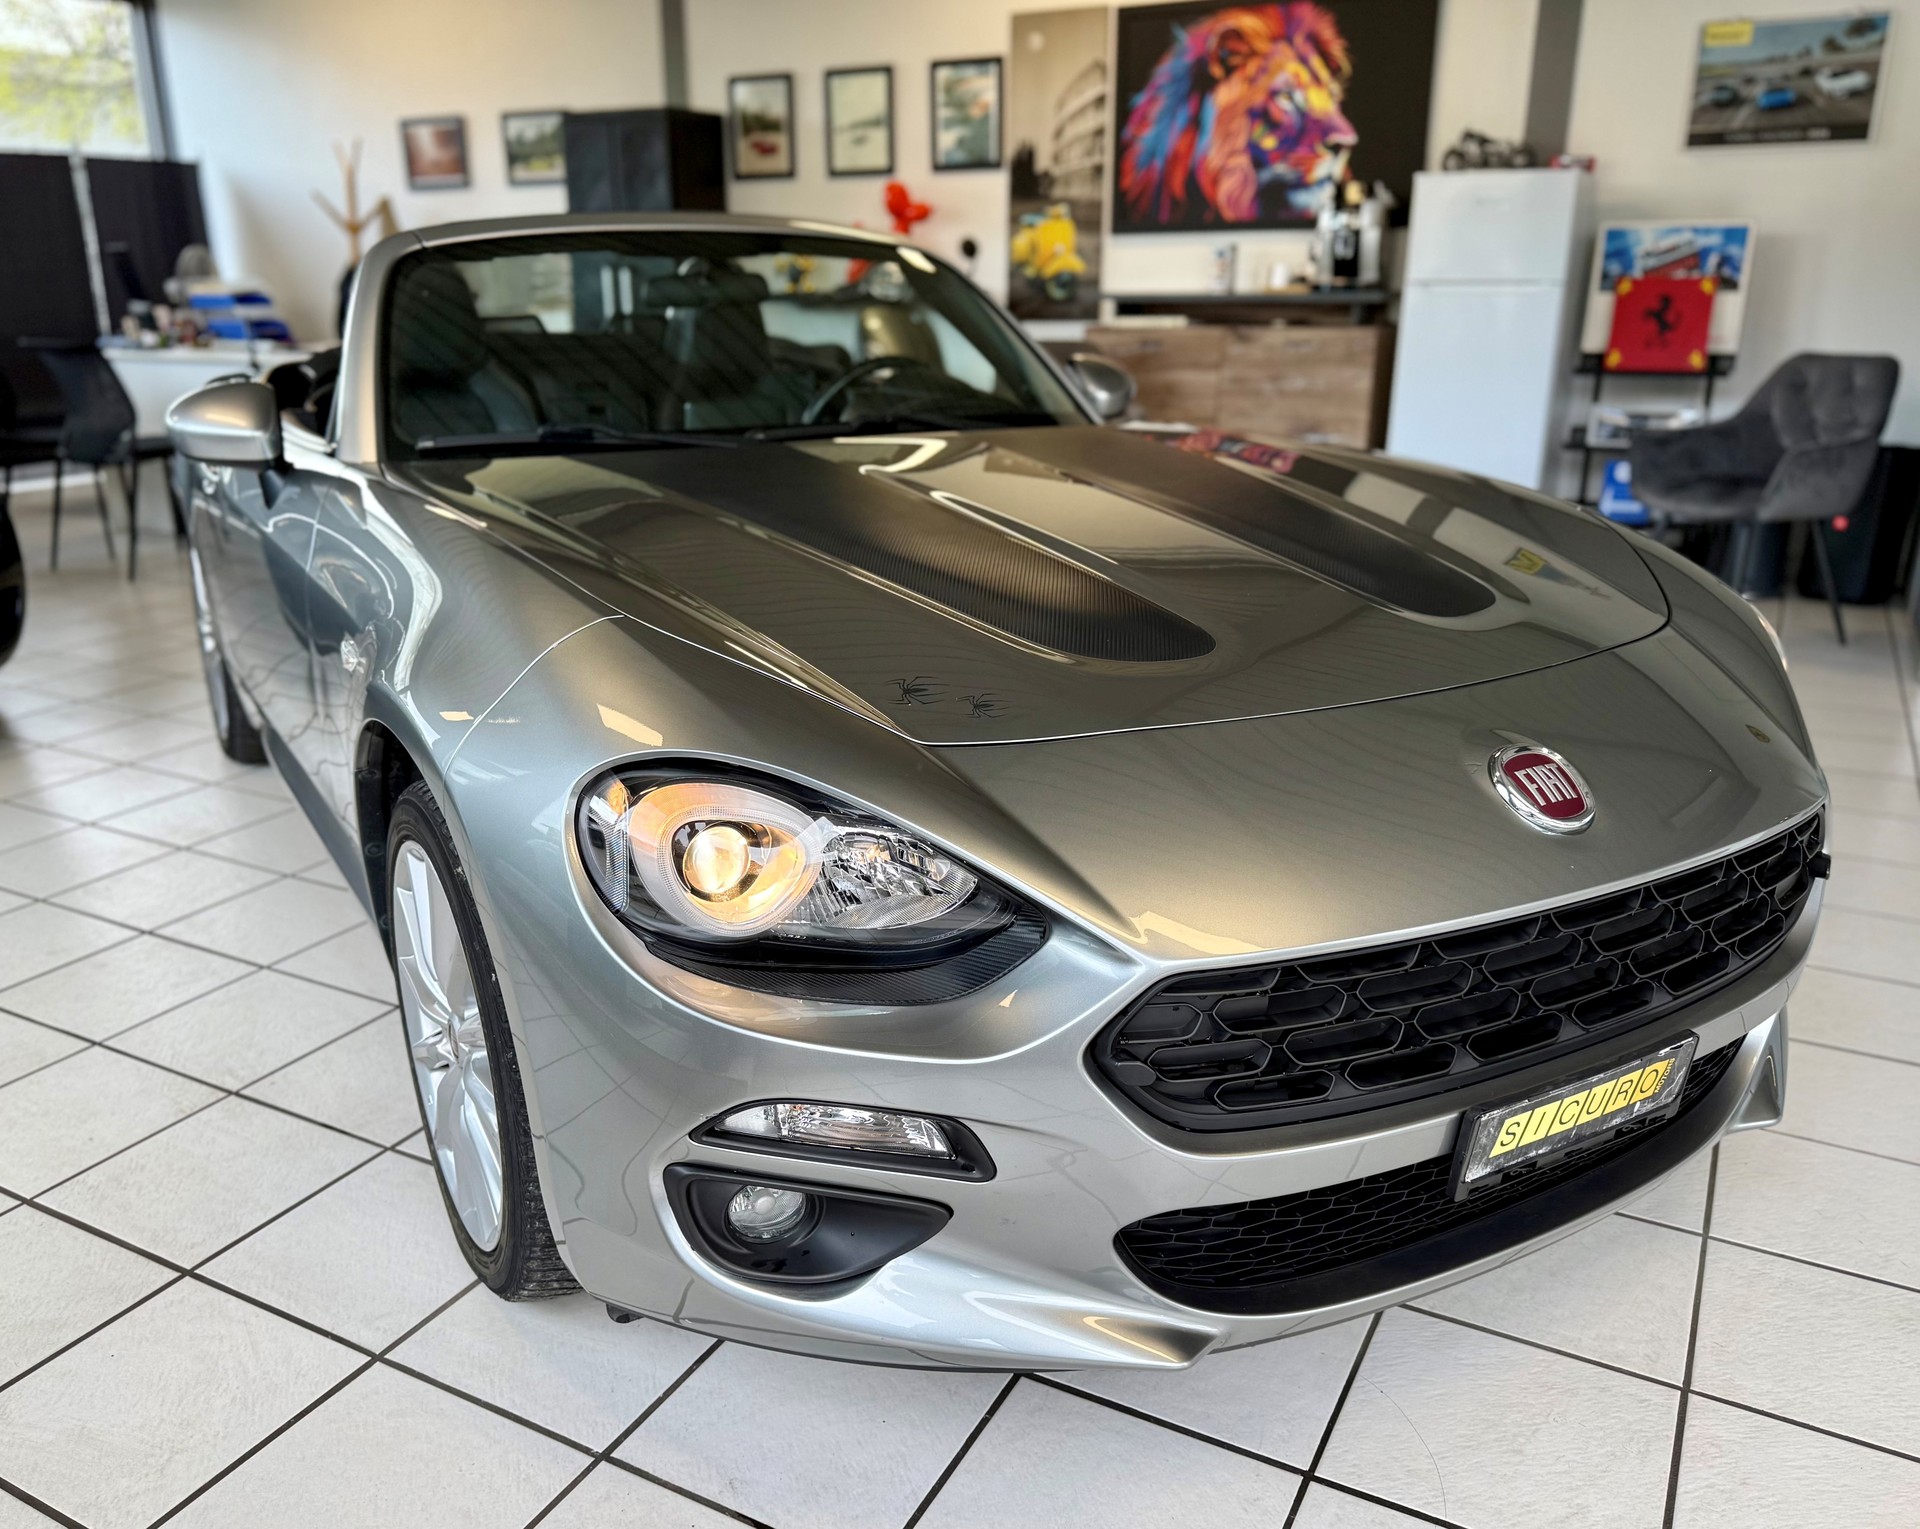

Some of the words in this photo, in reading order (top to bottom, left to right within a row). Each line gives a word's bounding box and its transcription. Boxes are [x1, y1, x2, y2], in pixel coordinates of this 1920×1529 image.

[1514, 763, 1578, 806] FIAT
[1654, 1057, 1676, 1094] MOTORS
[1500, 1069, 1659, 1147] SICURO
